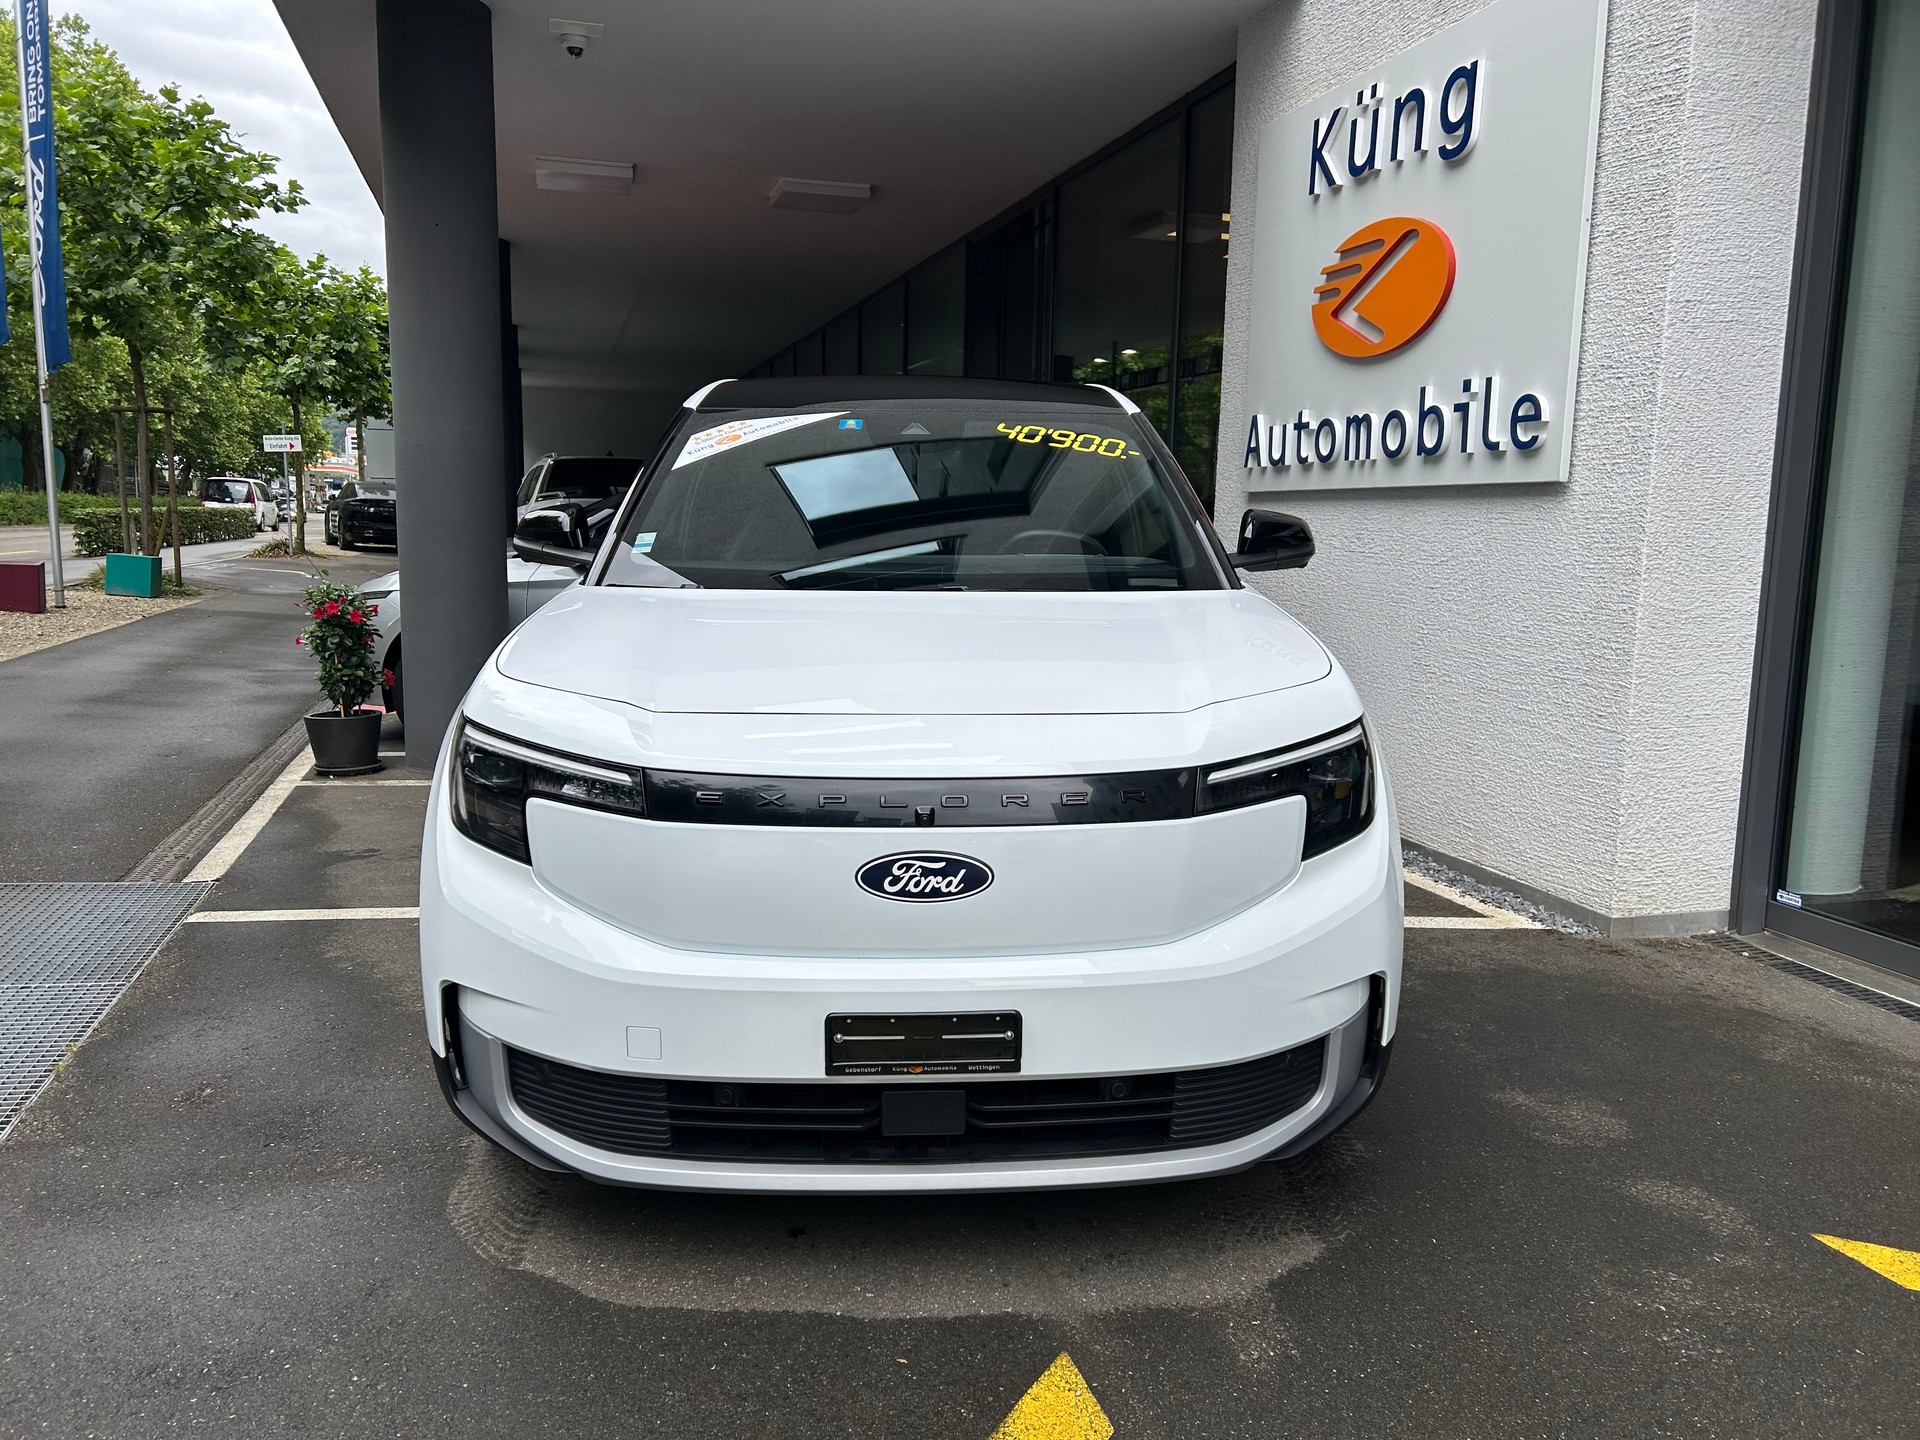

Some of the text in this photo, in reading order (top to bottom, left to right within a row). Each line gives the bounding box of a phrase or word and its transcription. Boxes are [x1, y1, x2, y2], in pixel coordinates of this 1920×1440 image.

[26, 1, 37, 123] BRING ON
[1308, 59, 1484, 196] Küng
[686, 442, 715, 456] Küng
[743, 416, 800, 436] Automobile
[996, 422, 1141, 460] 40'900.-
[1243, 376, 1550, 469] Automobile
[695, 788, 1148, 809] EXPLORER
[883, 859, 966, 895] Ford
